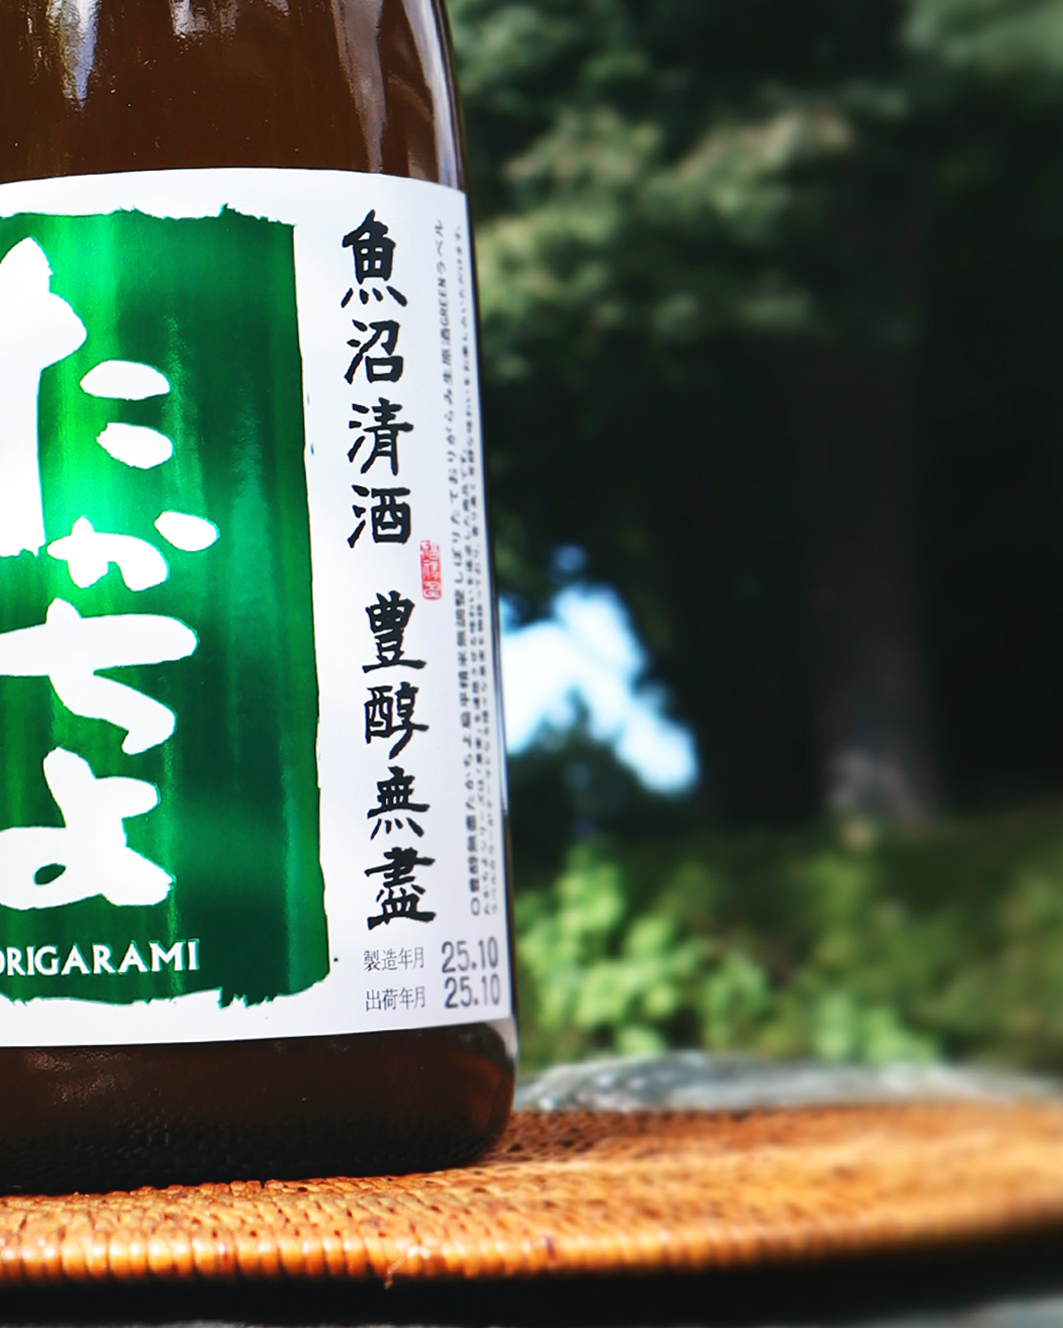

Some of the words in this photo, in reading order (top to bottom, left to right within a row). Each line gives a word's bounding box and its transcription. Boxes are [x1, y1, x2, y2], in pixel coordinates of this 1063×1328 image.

[340, 209, 415, 549] 魚沼清酒
[363, 946, 424, 972] 製造年月
[441, 936, 498, 973] 25.10
[365, 985, 426, 1012] 出荷年月
[444, 973, 501, 1009] 25.10
